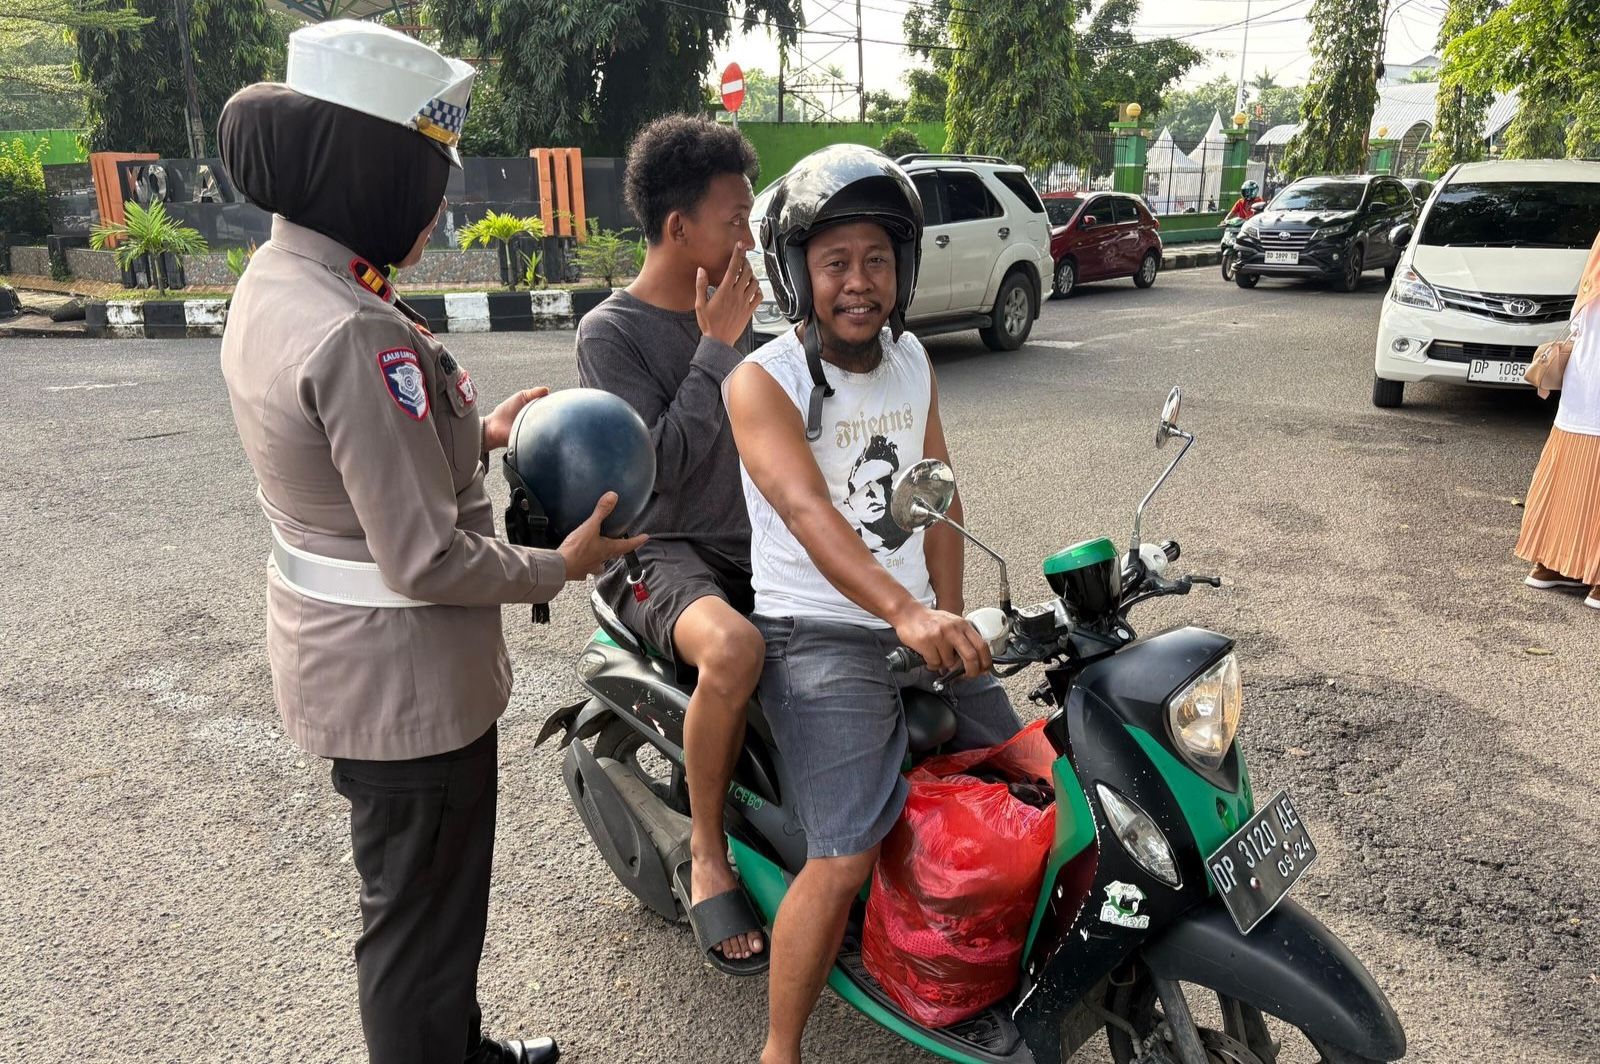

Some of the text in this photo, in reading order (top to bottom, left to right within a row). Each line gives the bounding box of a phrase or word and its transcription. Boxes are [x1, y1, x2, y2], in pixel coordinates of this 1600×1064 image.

[383, 351, 400, 362] LALU
[1474, 361, 1526, 376] DP 1085
[1212, 799, 1297, 894] DP 3120 AE
